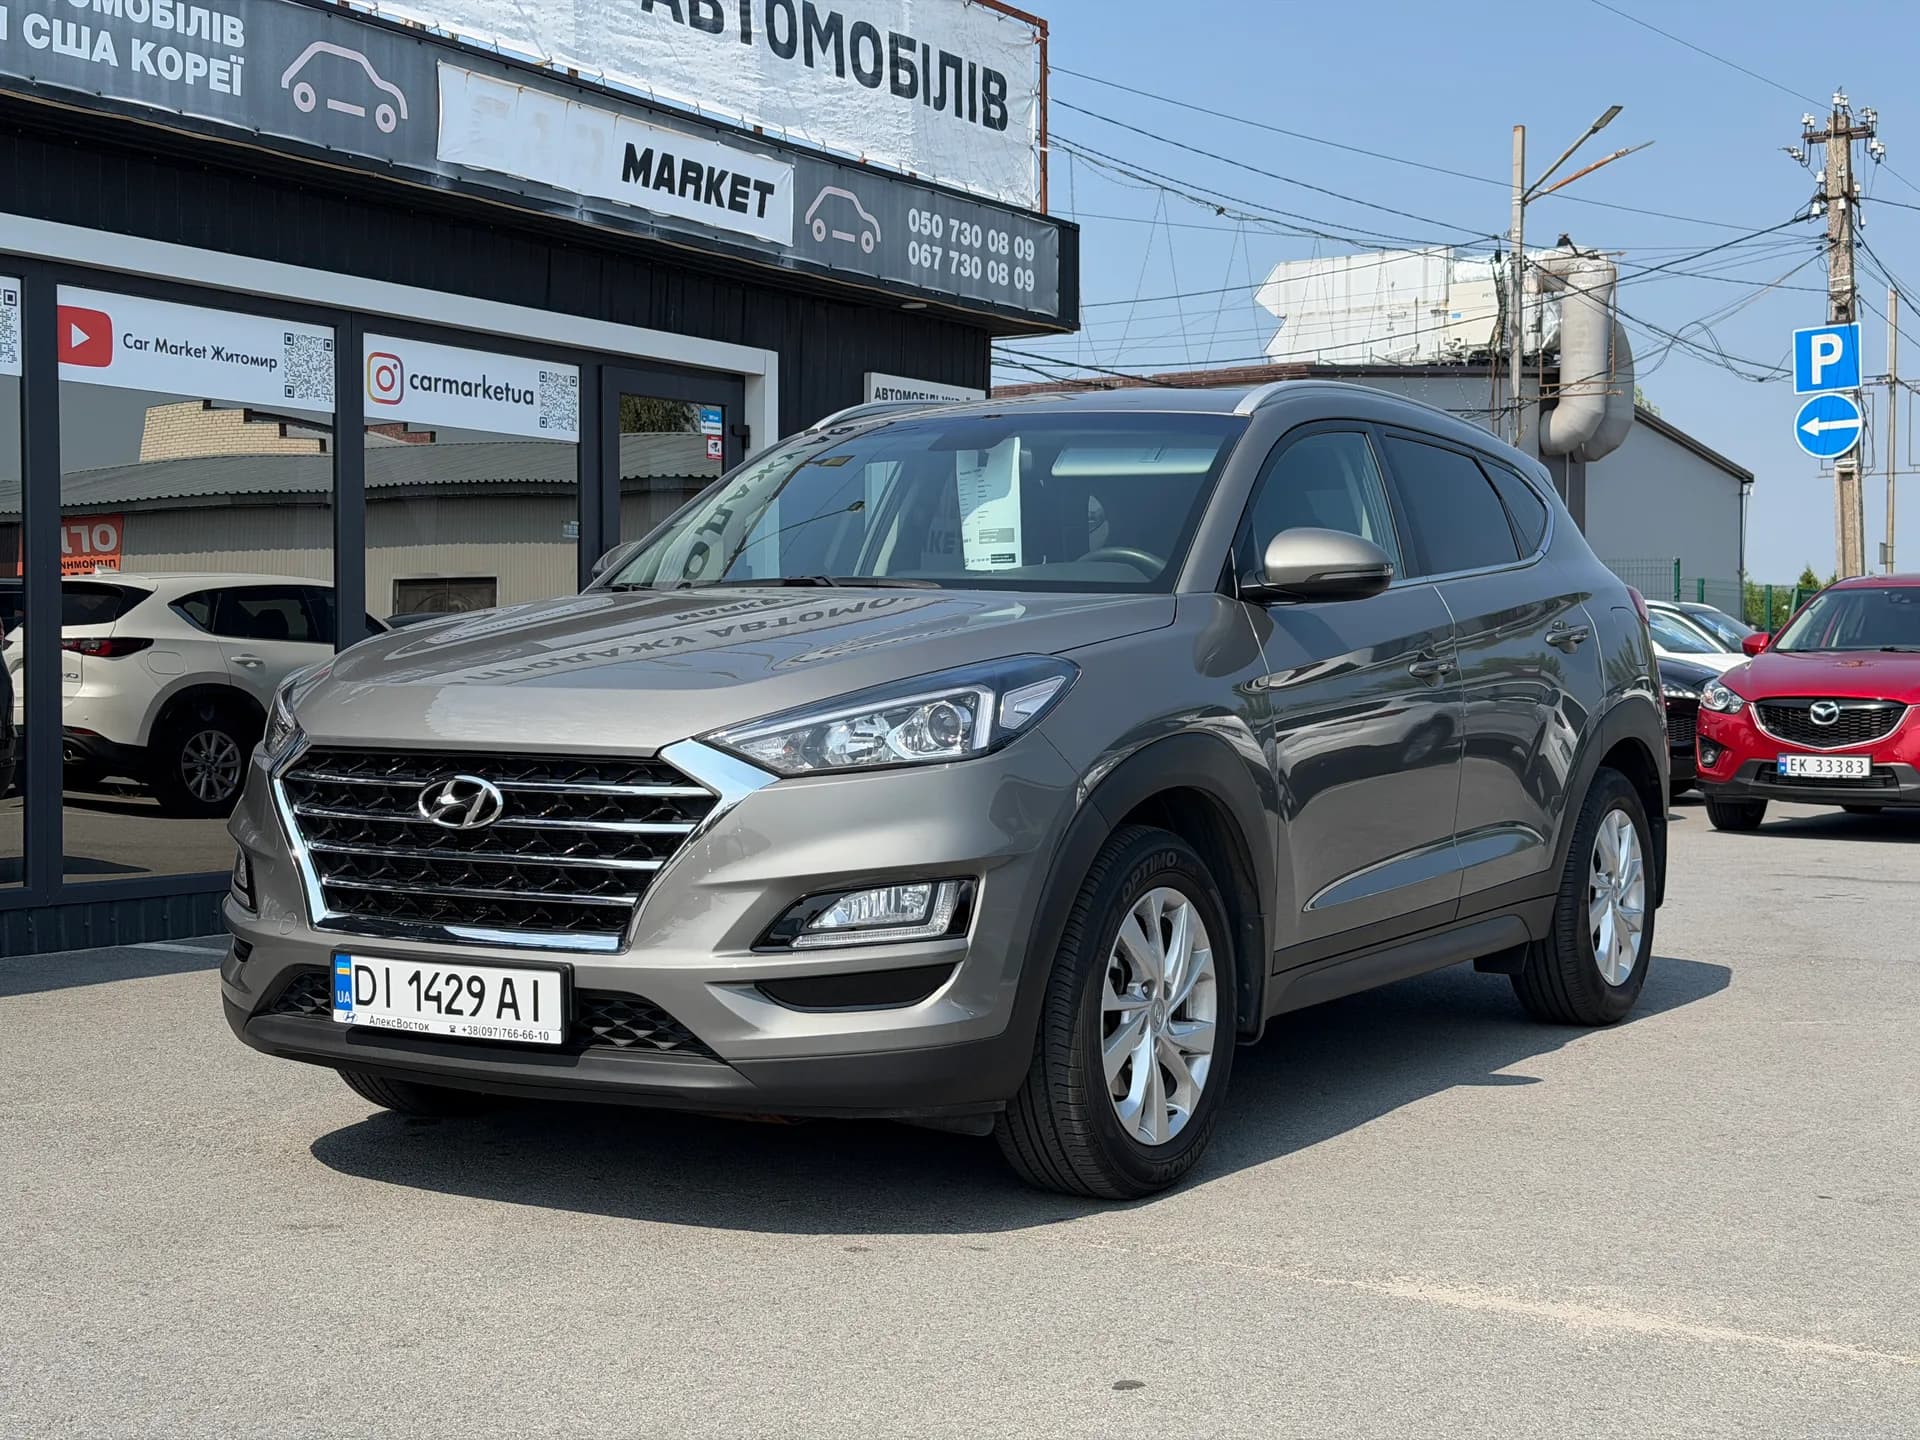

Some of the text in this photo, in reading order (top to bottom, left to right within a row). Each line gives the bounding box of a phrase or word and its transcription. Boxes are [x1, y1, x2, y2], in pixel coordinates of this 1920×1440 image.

[66, 0, 245, 48] МОБІЛІВ
[23, 13, 119, 67] США
[131, 38, 244, 96] КОРЕЇ
[640, 0, 1008, 132] ОМОБІЛІВ
[622, 142, 775, 219] MARKET
[908, 208, 1035, 262] 050 730 08 09
[908, 241, 1035, 292] 067 730 08 09
[123, 333, 278, 373] Car Market Житомир
[1811, 333, 1843, 385] P
[409, 374, 534, 405] carmarketua
[1790, 757, 1864, 774] EK 33383
[337, 990, 351, 1004] UA
[354, 964, 539, 1022] DI 1429 AI
[369, 1015, 549, 1041] АлексВосток +38(097)766-66-10
